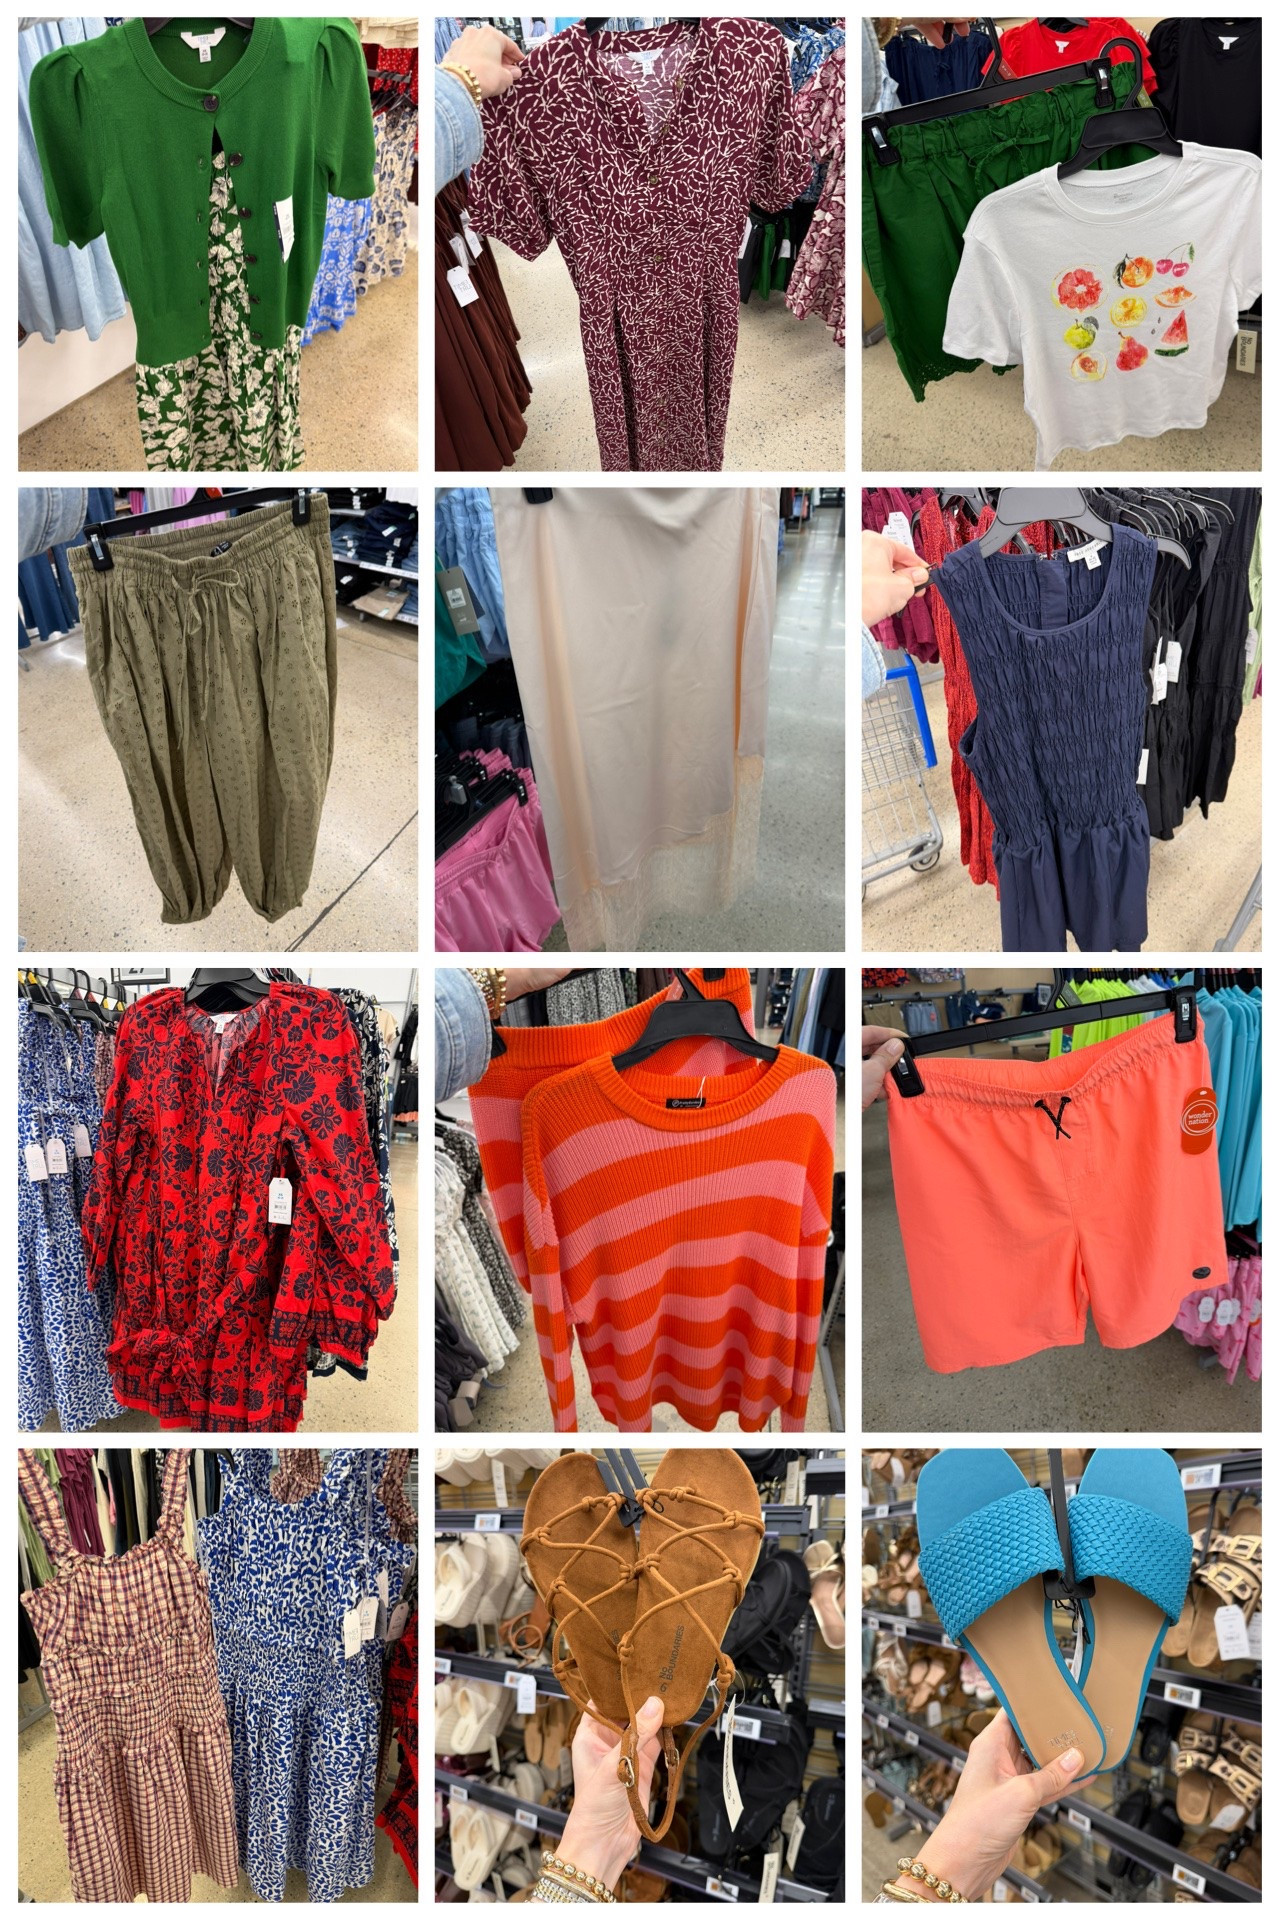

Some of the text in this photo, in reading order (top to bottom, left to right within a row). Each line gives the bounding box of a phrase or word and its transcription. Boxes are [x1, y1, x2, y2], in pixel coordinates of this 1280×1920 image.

[1187, 1110, 1212, 1119] wonder
[666, 1625, 685, 1681] BOUNDARIES
[660, 1682, 668, 1693] 6
